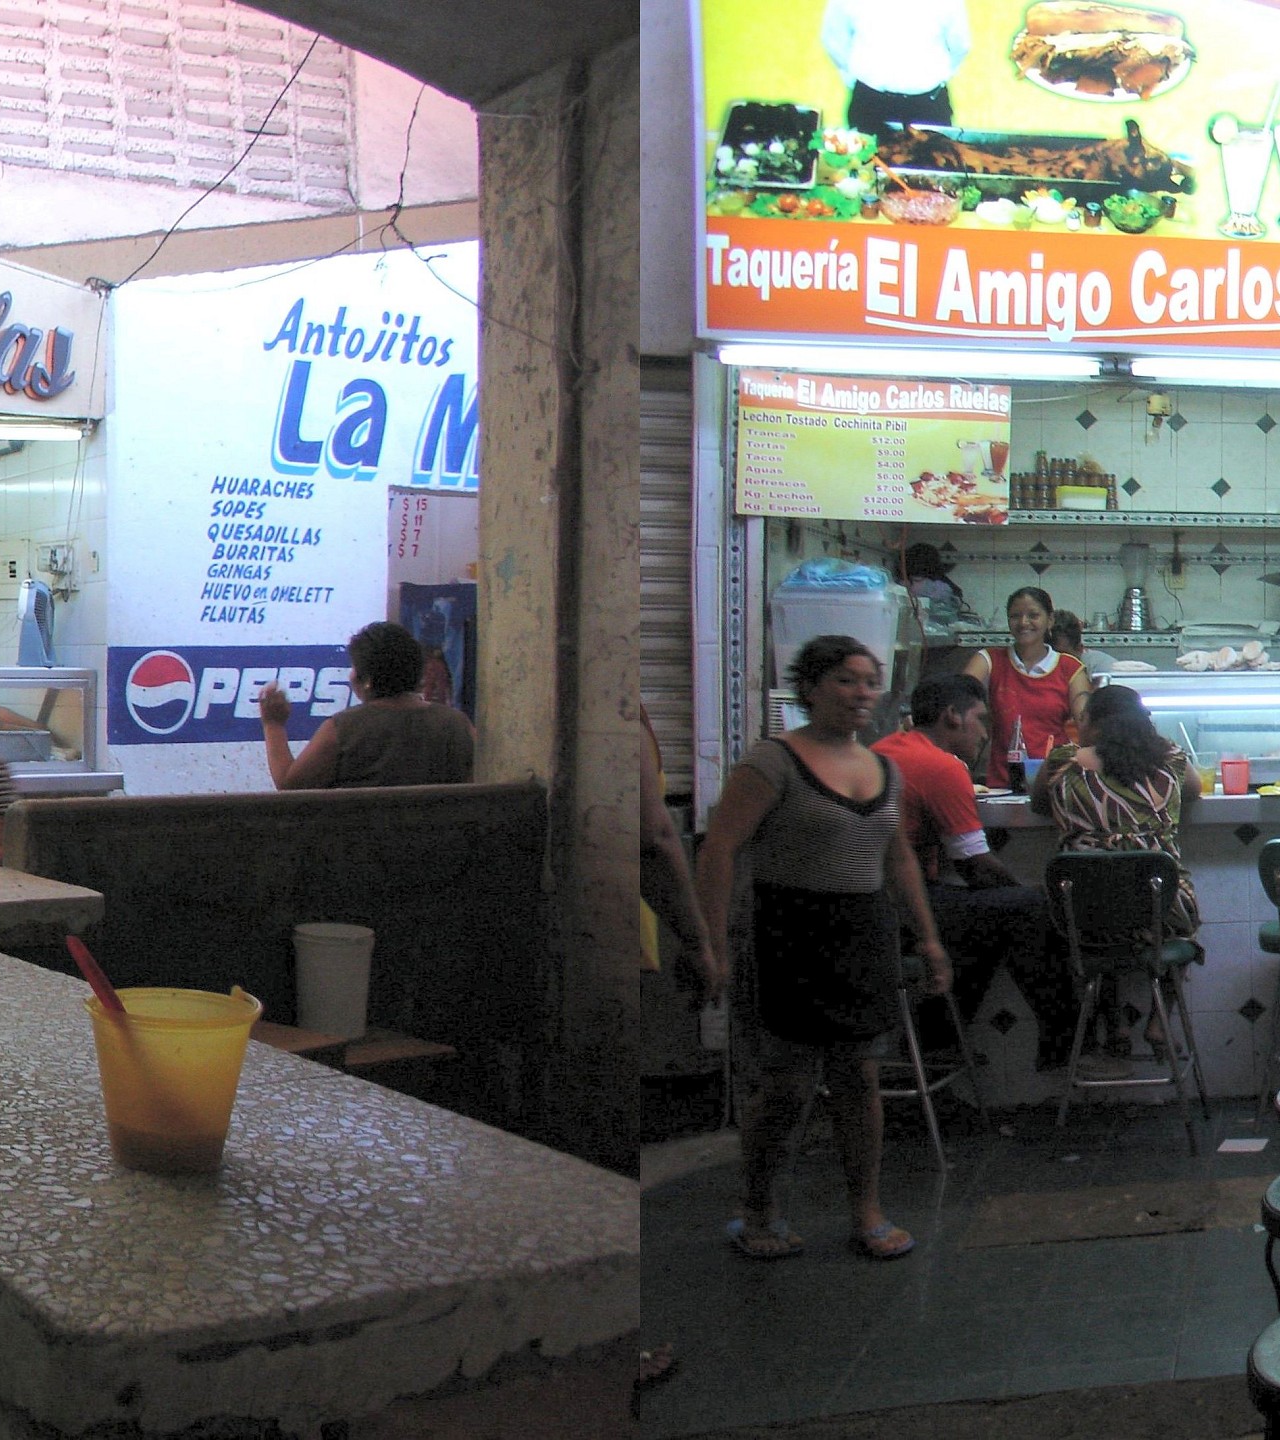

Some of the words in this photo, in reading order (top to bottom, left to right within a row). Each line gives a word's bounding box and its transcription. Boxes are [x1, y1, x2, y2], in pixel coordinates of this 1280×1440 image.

[707, 234, 858, 301] Taquería
[866, 236, 918, 318] El
[936, 246, 1111, 342] Amigo
[263, 297, 454, 367] Antojitos
[797, 379, 816, 405] El
[822, 382, 880, 414] Amigo
[885, 385, 944, 410] Carlos
[949, 384, 1009, 413] Ruelas
[270, 359, 388, 481] La
[786, 413, 828, 427] Tostado
[834, 417, 882, 431] Cochinita
[885, 420, 907, 432] Pibil
[746, 428, 797, 439] Trancas
[872, 437, 905, 446] $12.00
[746, 440, 786, 450] Tortas
[746, 452, 783, 462] Tacos
[745, 465, 783, 475] Aguas
[211, 476, 314, 499] HUARACHES
[745, 477, 807, 488] Refrescos
[211, 500, 267, 520] SOPES
[769, 503, 820, 514] Especial
[863, 496, 904, 505] $120.00
[207, 522, 322, 546] QUESADILLAS
[212, 543, 295, 563] BURRITAS
[207, 563, 272, 582] GRINGAS
[201, 582, 252, 601] HUEVO
[270, 585, 334, 604] OMELETT
[200, 603, 266, 624] FLAUTAS
[193, 666, 363, 719] PEPS
